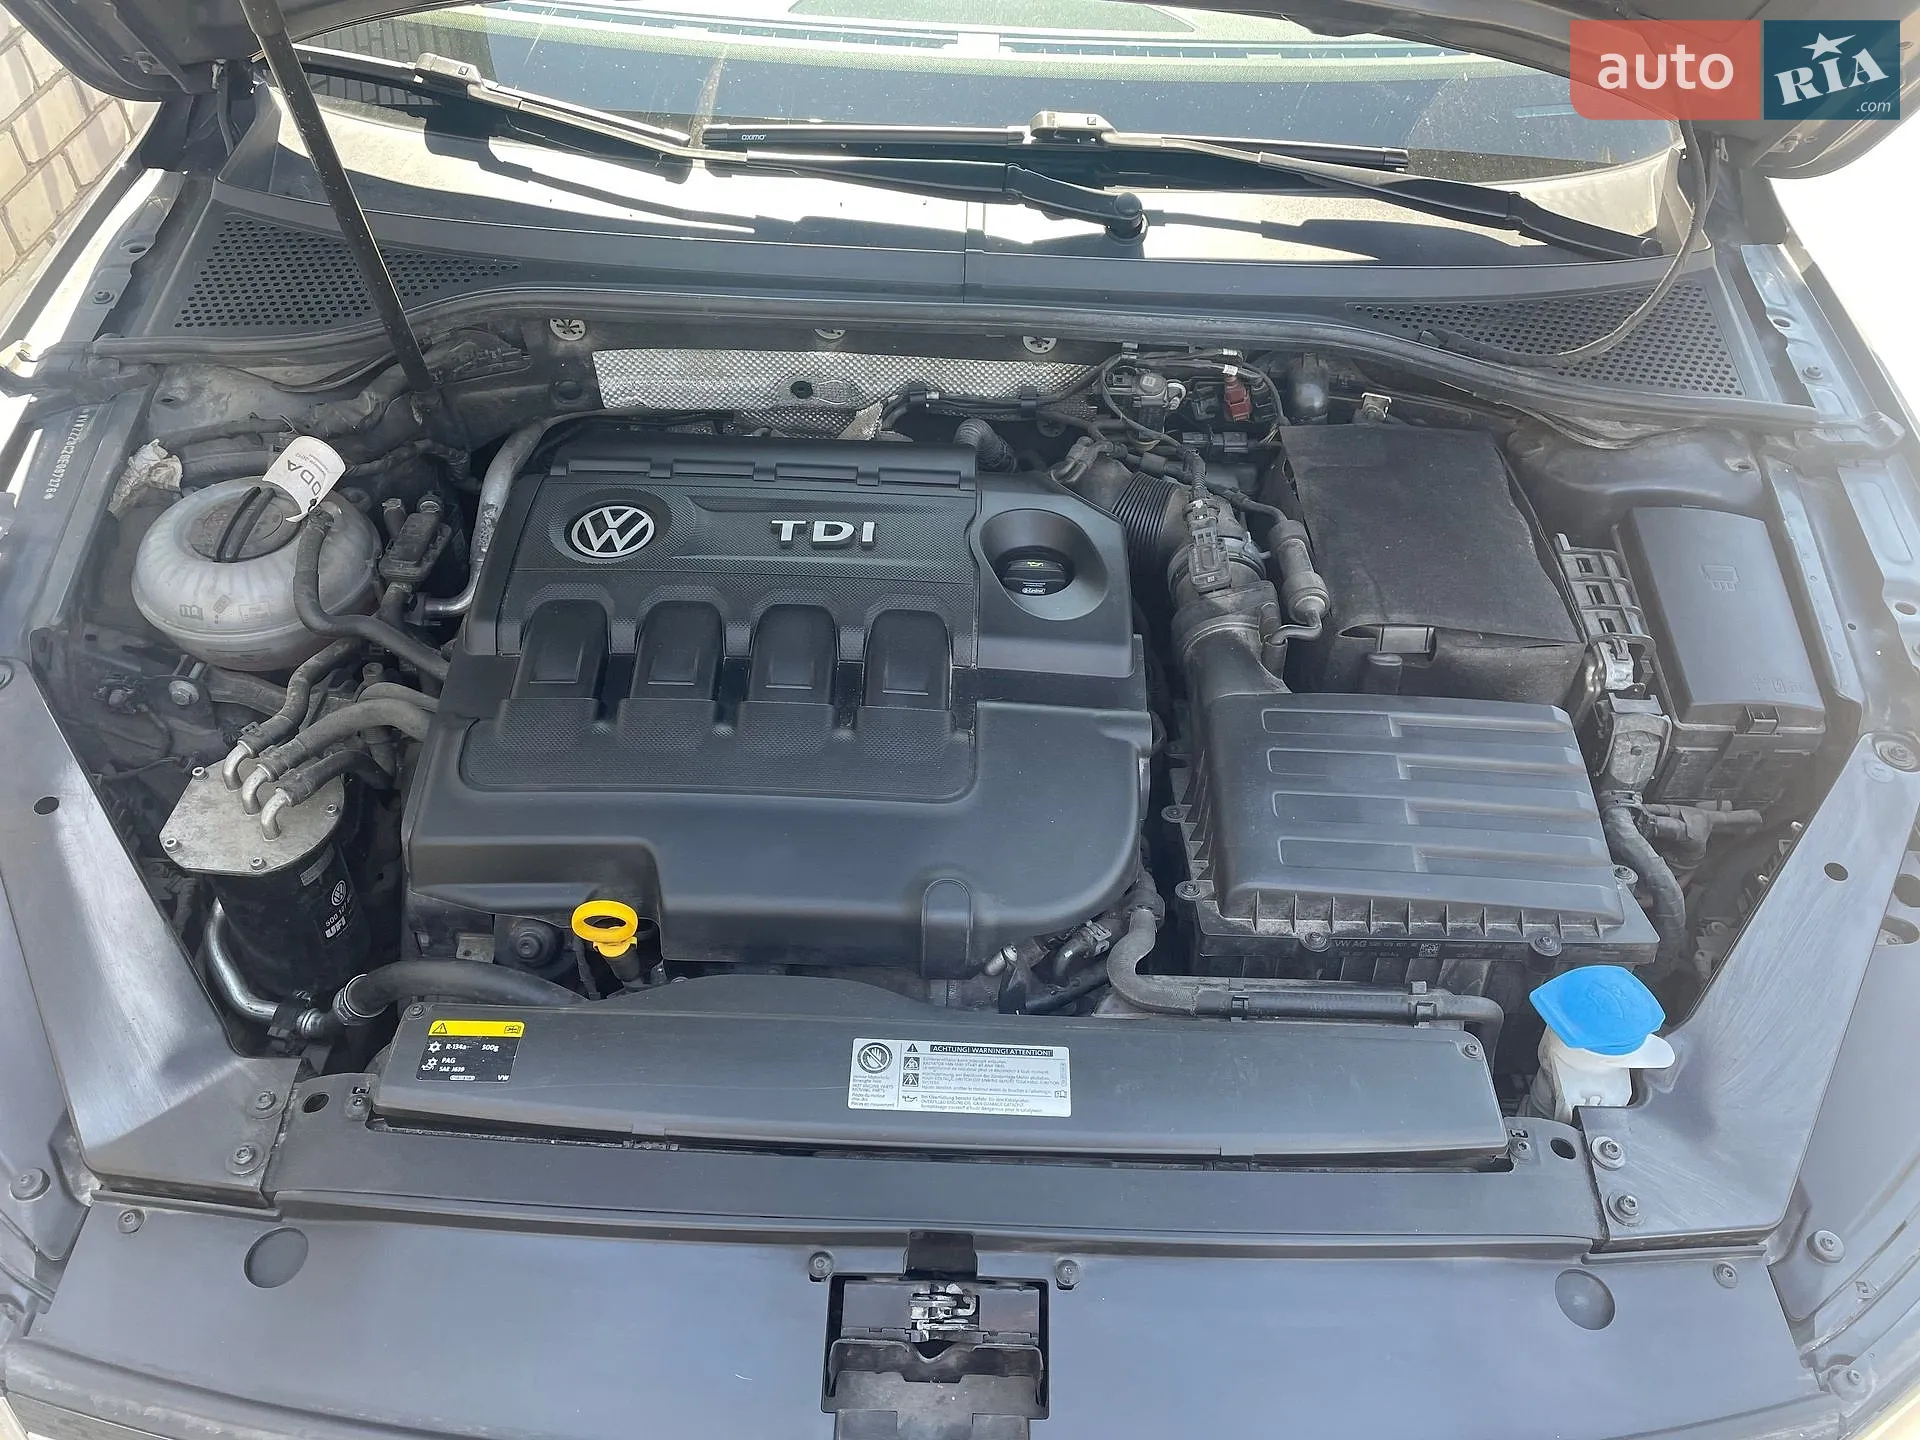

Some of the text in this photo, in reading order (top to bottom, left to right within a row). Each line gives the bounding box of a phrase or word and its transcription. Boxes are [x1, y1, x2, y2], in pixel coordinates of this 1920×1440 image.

[771, 519, 876, 546] TDI
[932, 1045, 970, 1053] ACHTUNG!
[971, 1047, 1008, 1055] WARNING!
